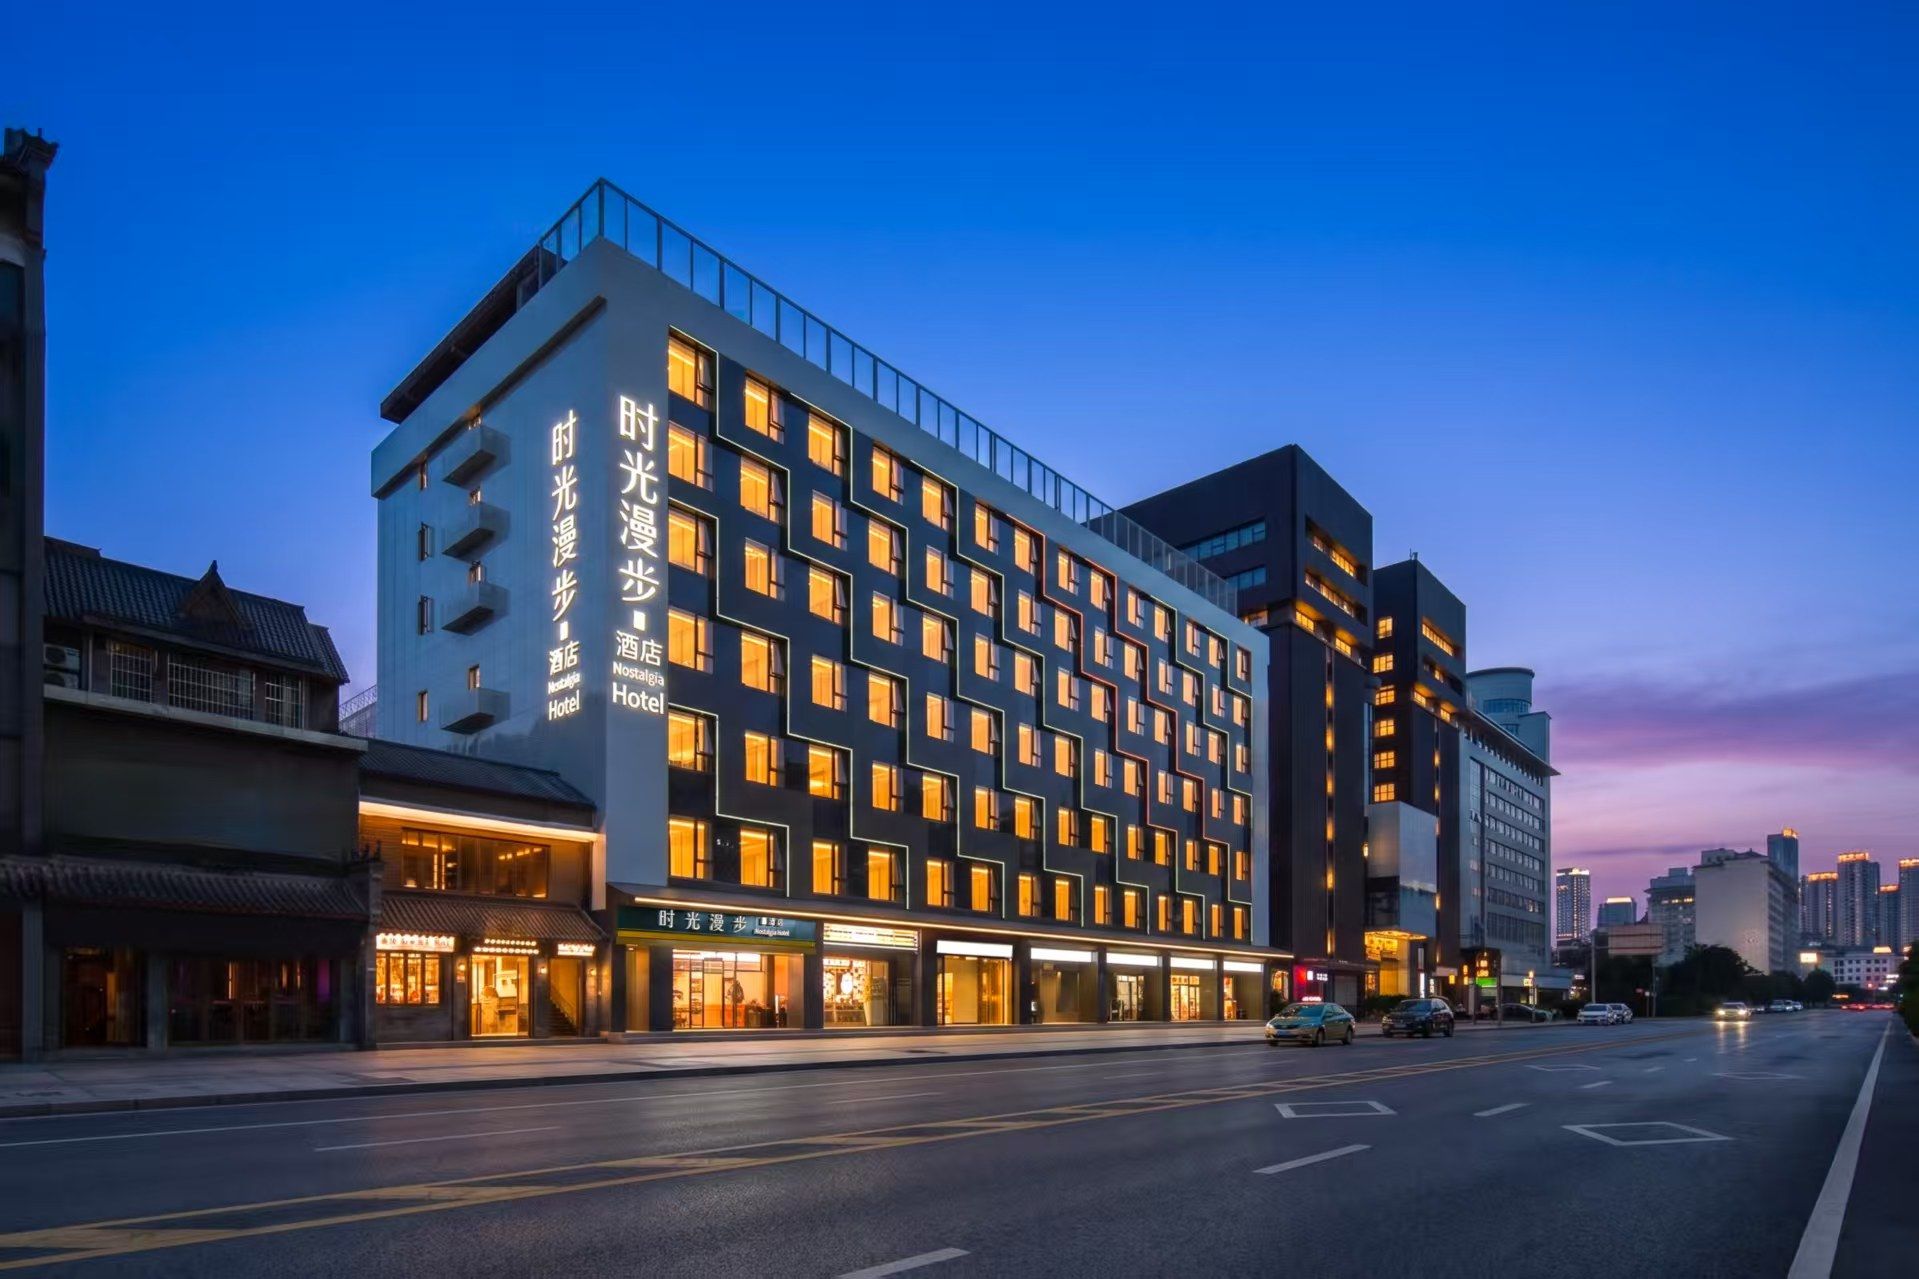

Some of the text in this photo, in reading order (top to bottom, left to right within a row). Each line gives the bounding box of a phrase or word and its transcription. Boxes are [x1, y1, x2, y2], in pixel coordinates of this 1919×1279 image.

[619, 394, 660, 602] 时光漫步
[551, 409, 578, 622] 时光漫步
[549, 640, 580, 675] 酒店
[616, 629, 663, 667] 酒店
[612, 661, 665, 687] Nostalgia
[548, 689, 580, 721] Hotel
[612, 682, 665, 715] Hotel
[658, 909, 748, 933] 时光漫步
